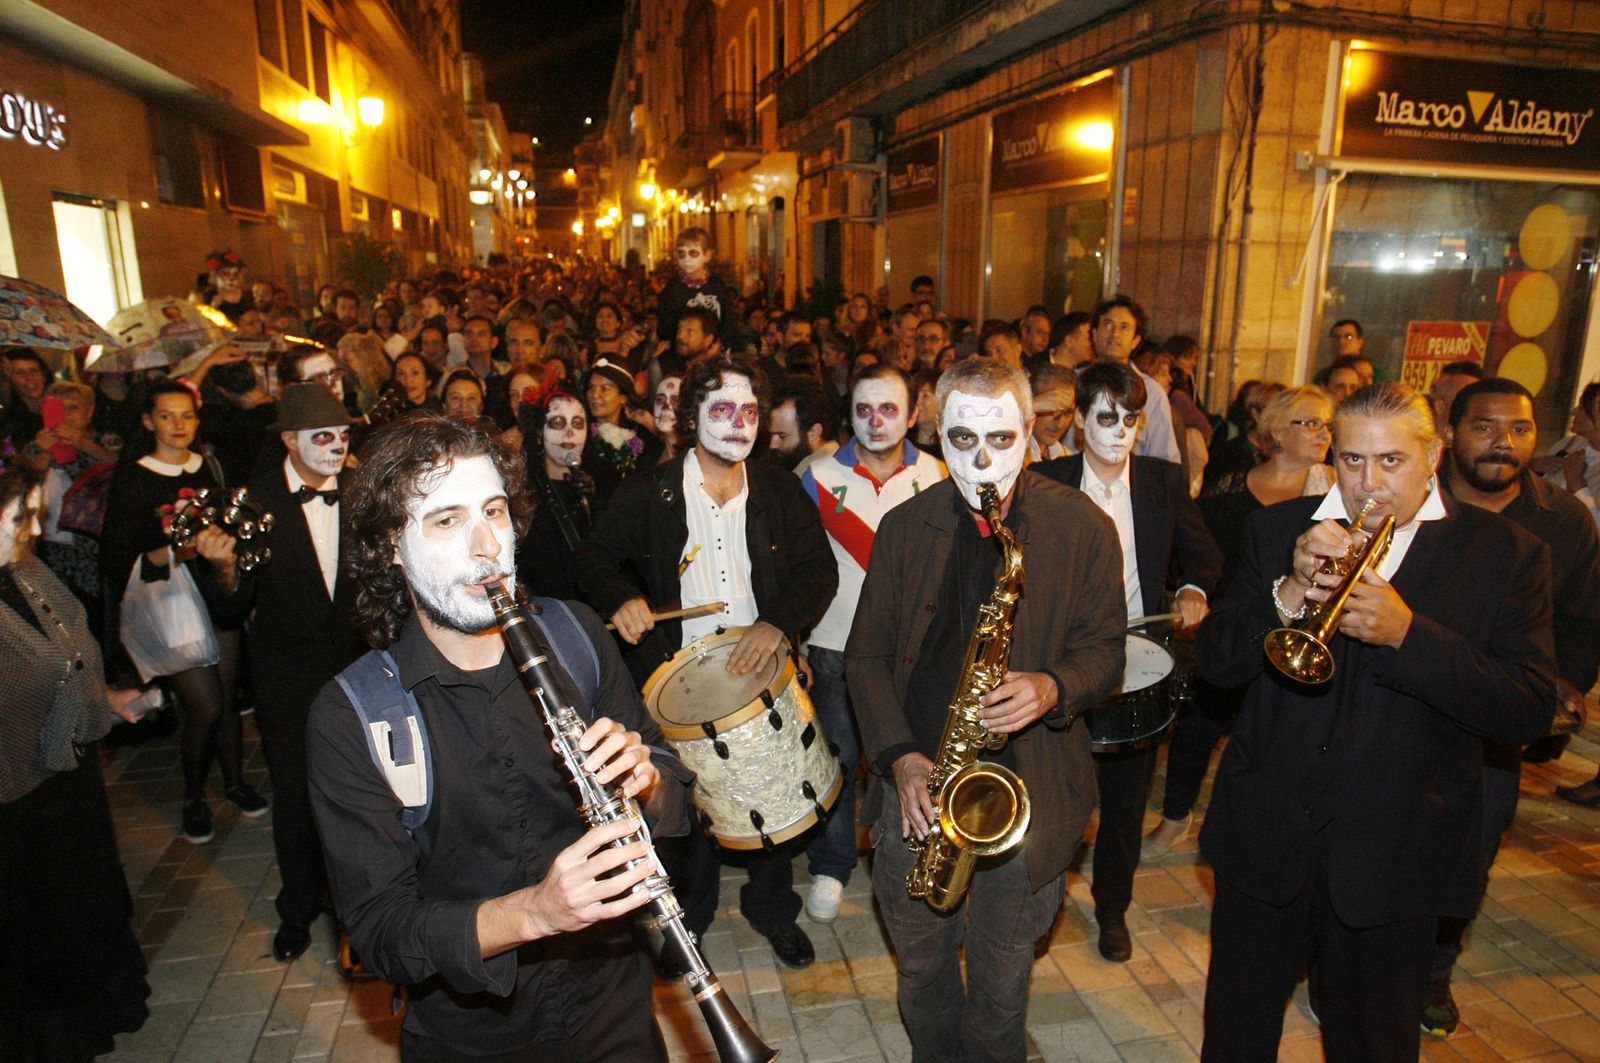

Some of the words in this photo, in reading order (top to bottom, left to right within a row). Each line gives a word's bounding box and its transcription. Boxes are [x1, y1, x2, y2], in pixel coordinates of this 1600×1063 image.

[1375, 91, 1466, 128] Marco
[1484, 99, 1589, 145] Aldany
[1428, 337, 1471, 355] PEVARO
[1404, 362, 1427, 392] 959
[831, 484, 848, 513] 7
